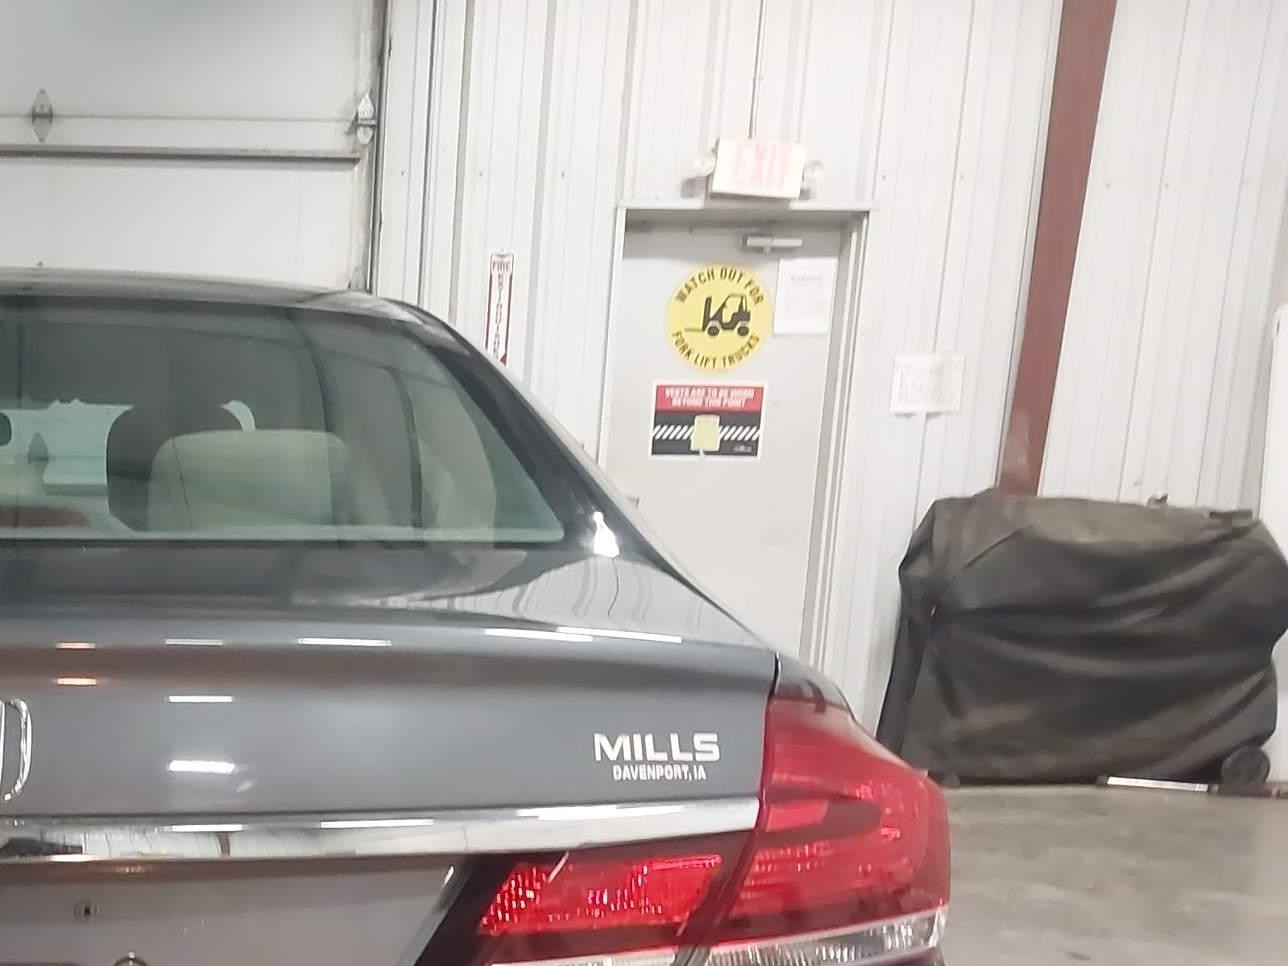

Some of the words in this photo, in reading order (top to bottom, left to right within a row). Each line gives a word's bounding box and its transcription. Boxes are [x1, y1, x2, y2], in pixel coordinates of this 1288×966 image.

[675, 267, 715, 303] WATCH
[720, 266, 744, 284] OUT
[744, 278, 765, 305] FOR
[672, 331, 694, 361] FORK
[694, 353, 717, 369] LIFT
[723, 334, 760, 369] TRUCKS
[593, 732, 721, 762] MILLS
